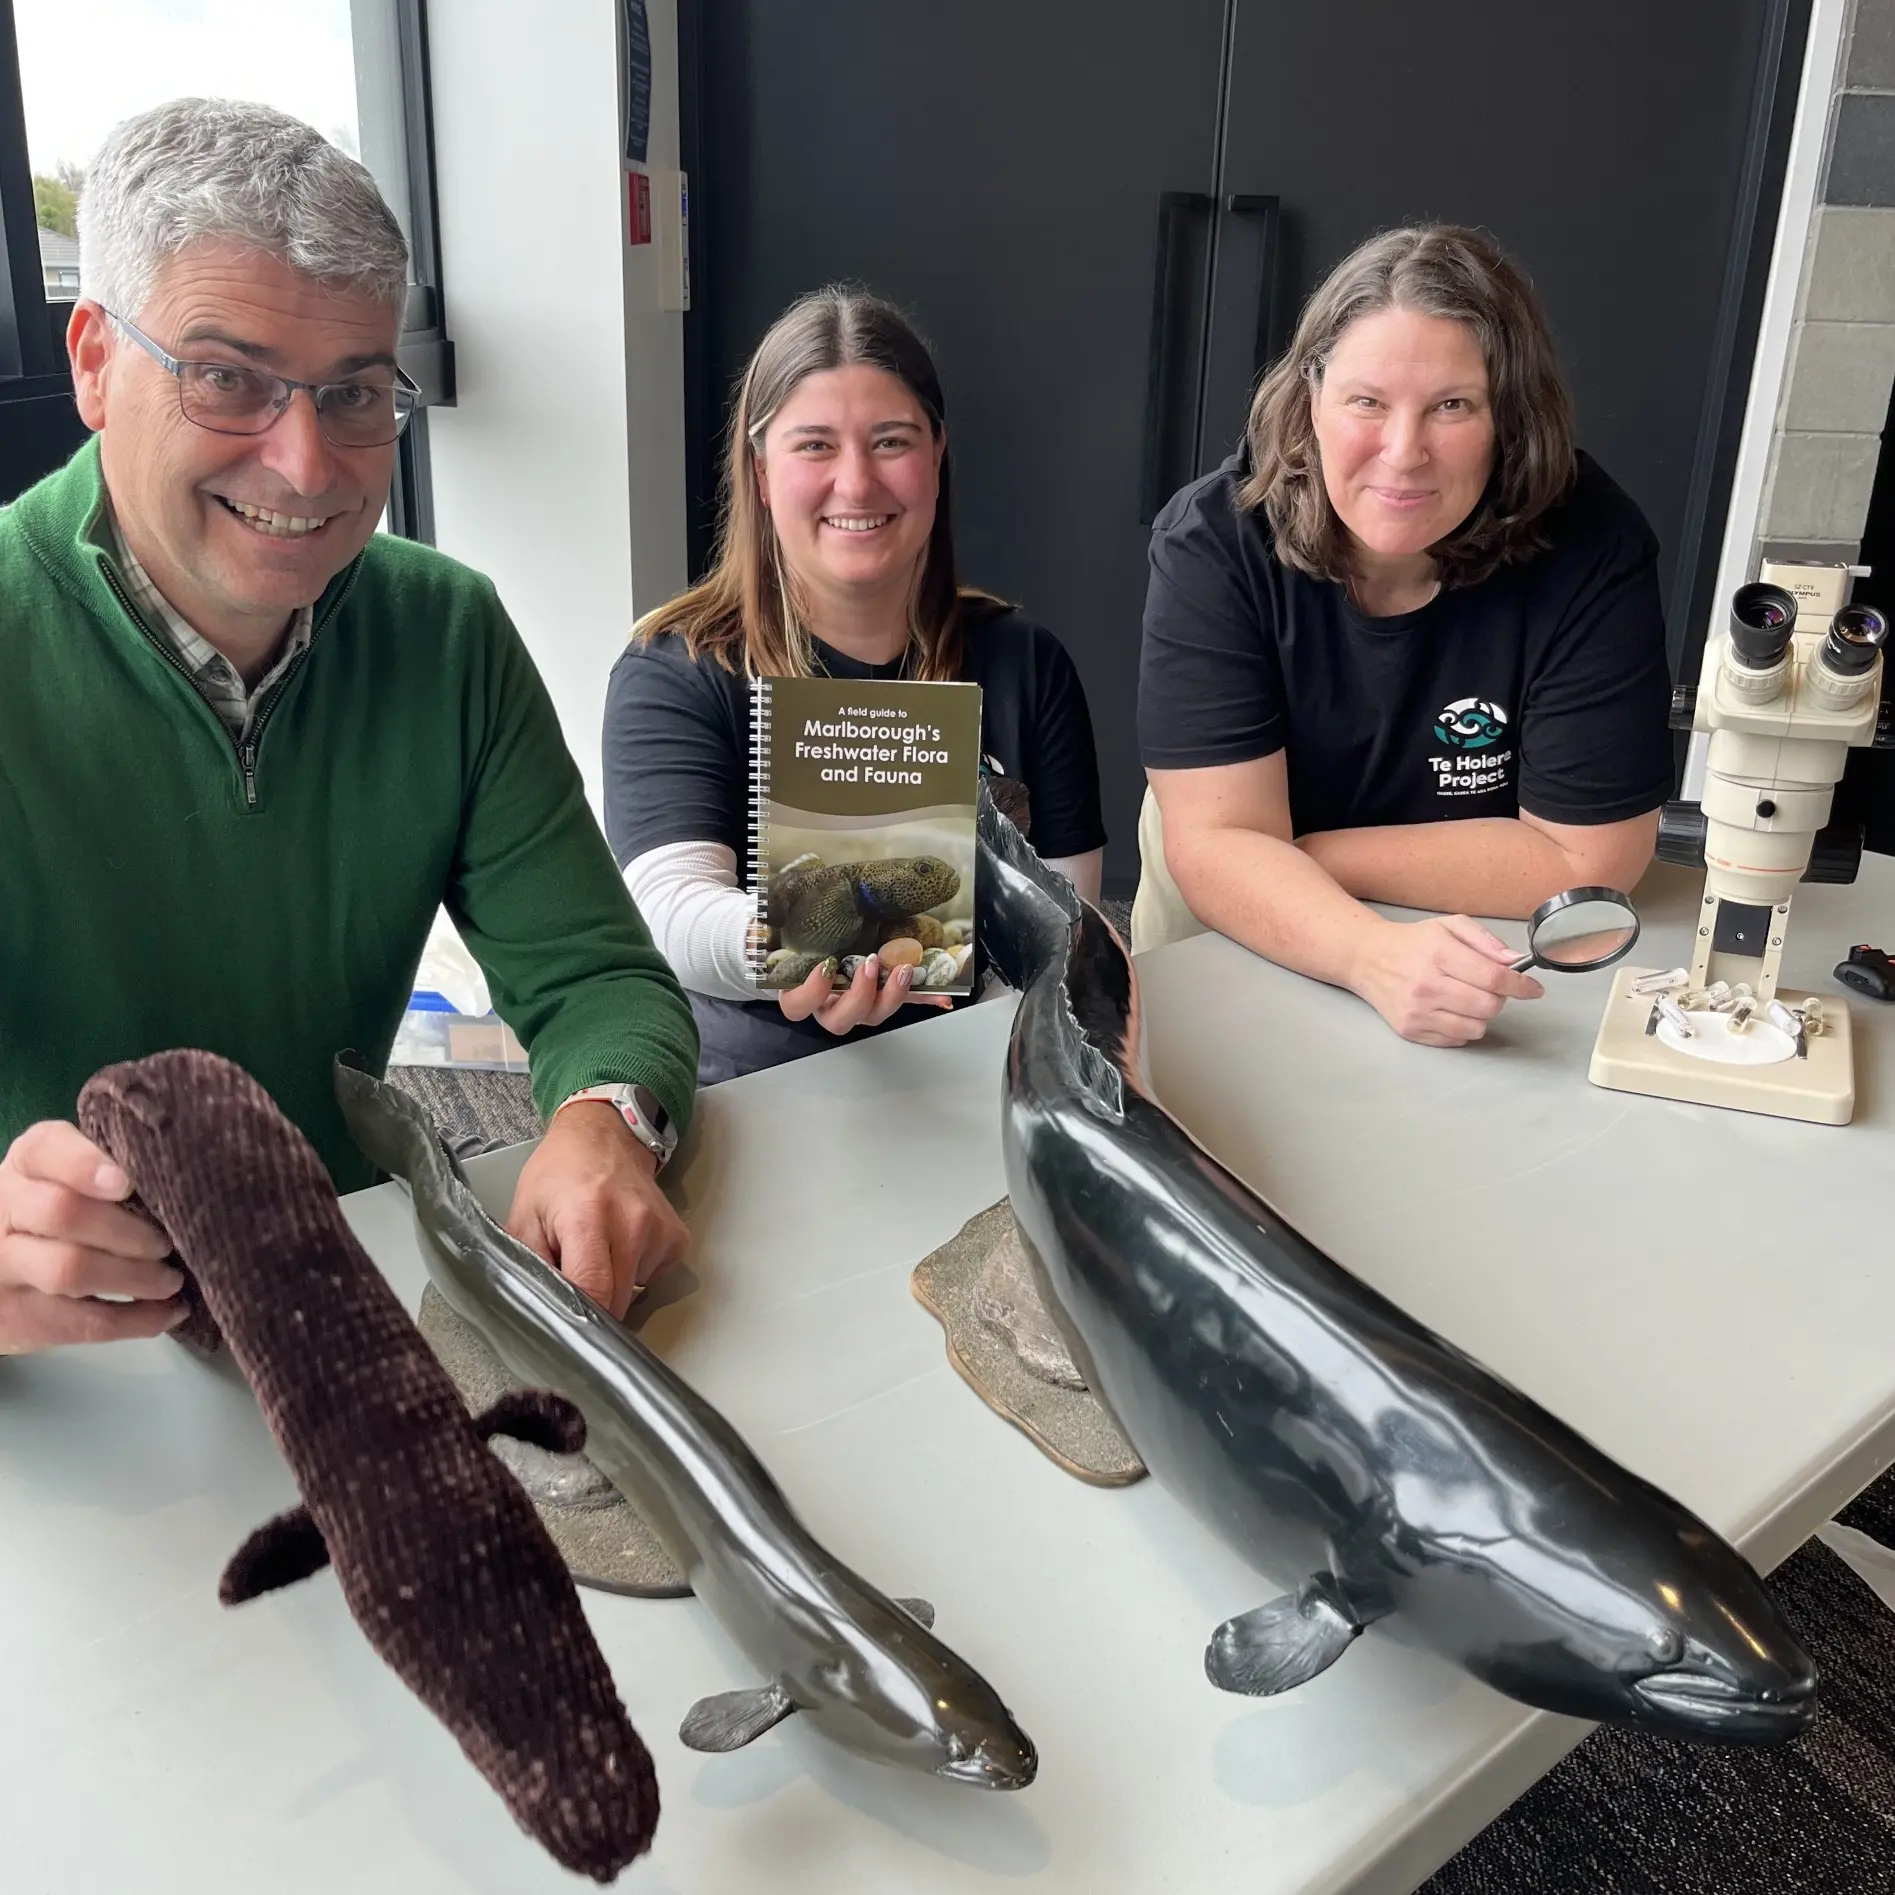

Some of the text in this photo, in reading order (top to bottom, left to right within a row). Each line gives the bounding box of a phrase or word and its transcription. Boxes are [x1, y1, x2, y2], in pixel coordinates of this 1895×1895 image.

[838, 707, 907, 718] A field guide to
[803, 720, 941, 744] Marlborough's
[795, 742, 948, 764] Freshwater Flora
[1428, 757, 1451, 771] Te
[820, 766, 922, 785] and Fauna
[1439, 768, 1505, 789] Project
